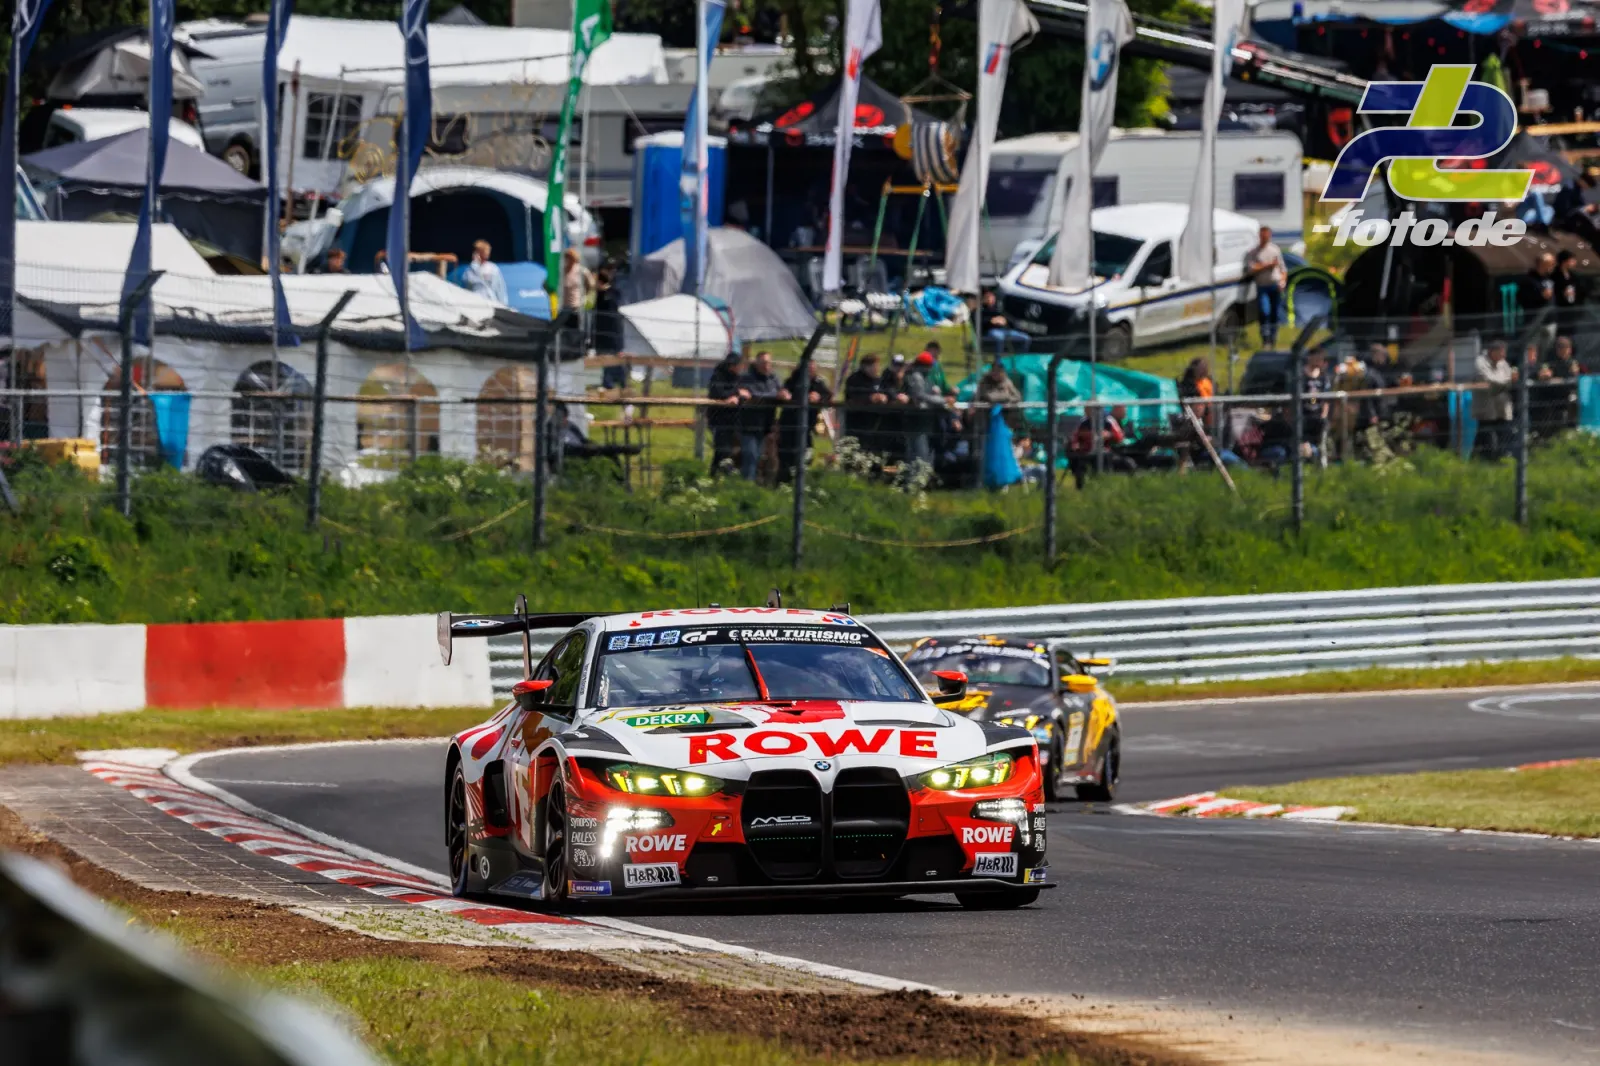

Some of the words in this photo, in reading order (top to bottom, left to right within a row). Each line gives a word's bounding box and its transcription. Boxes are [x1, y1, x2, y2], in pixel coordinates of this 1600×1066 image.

[636, 712, 701, 726] DEKRA
[679, 728, 938, 764] ROWE
[625, 834, 687, 853] ROWE
[960, 826, 1013, 844] ROWE
